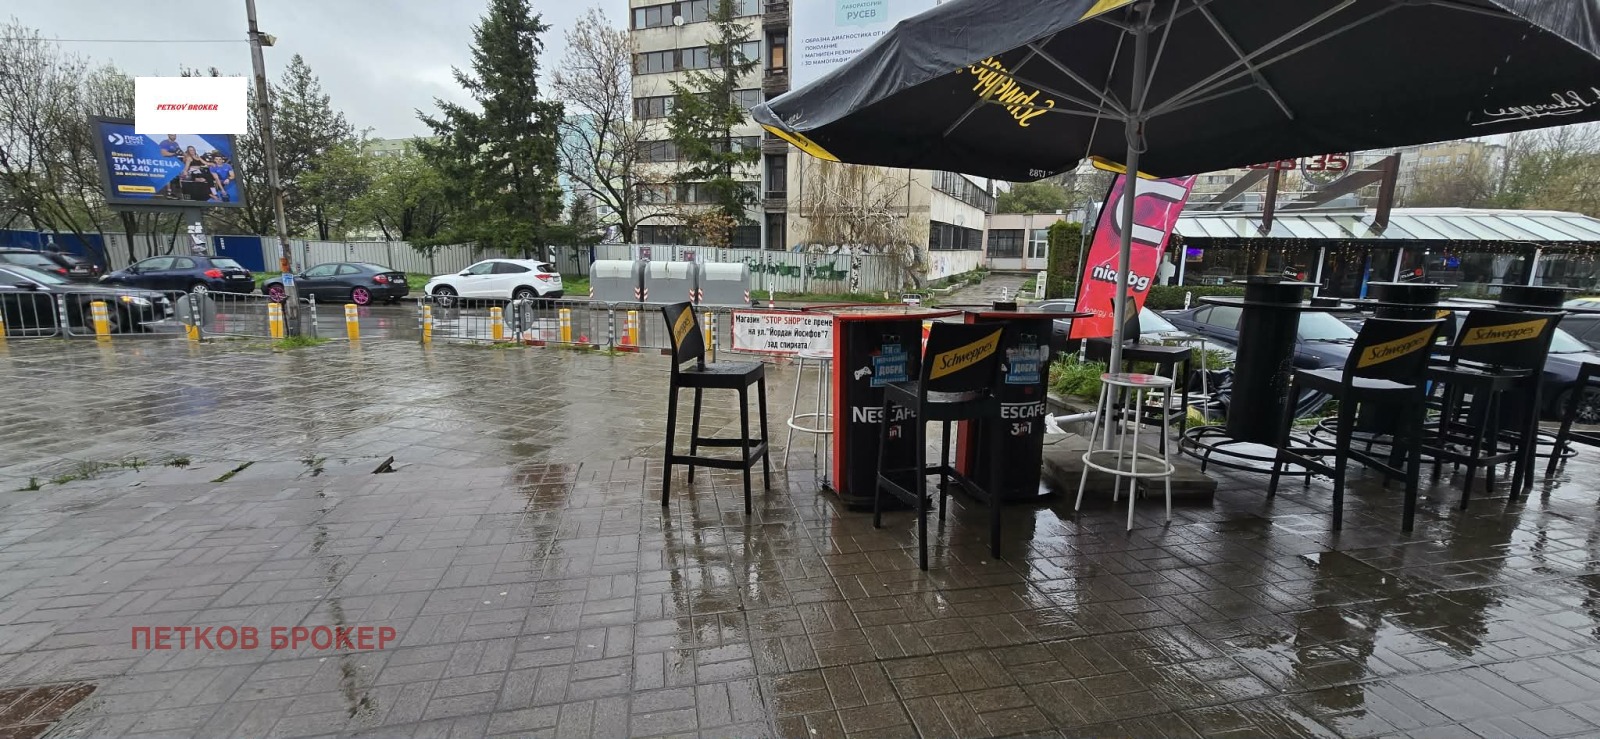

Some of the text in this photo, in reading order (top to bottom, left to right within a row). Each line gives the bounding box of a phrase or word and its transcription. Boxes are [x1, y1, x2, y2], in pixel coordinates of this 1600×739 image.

[847, 9, 876, 20] РУСЕВ
[805, 36, 831, 44] ОБРАЗНА
[831, 32, 872, 42] ДИАГНОСТИКА
[805, 43, 838, 51] ПОКОЛЕНИЕ
[113, 156, 181, 168] ТРИ МЕСЕЦА
[114, 163, 129, 171] ЗА
[735, 314, 760, 324] Магазин
[813, 318, 833, 327] преме
[1474, 326, 1535, 341] Schweppes
[1367, 336, 1427, 361] Schweppes
[939, 342, 993, 371] Schweppes
[1000, 401, 1045, 419] ESCAFE
